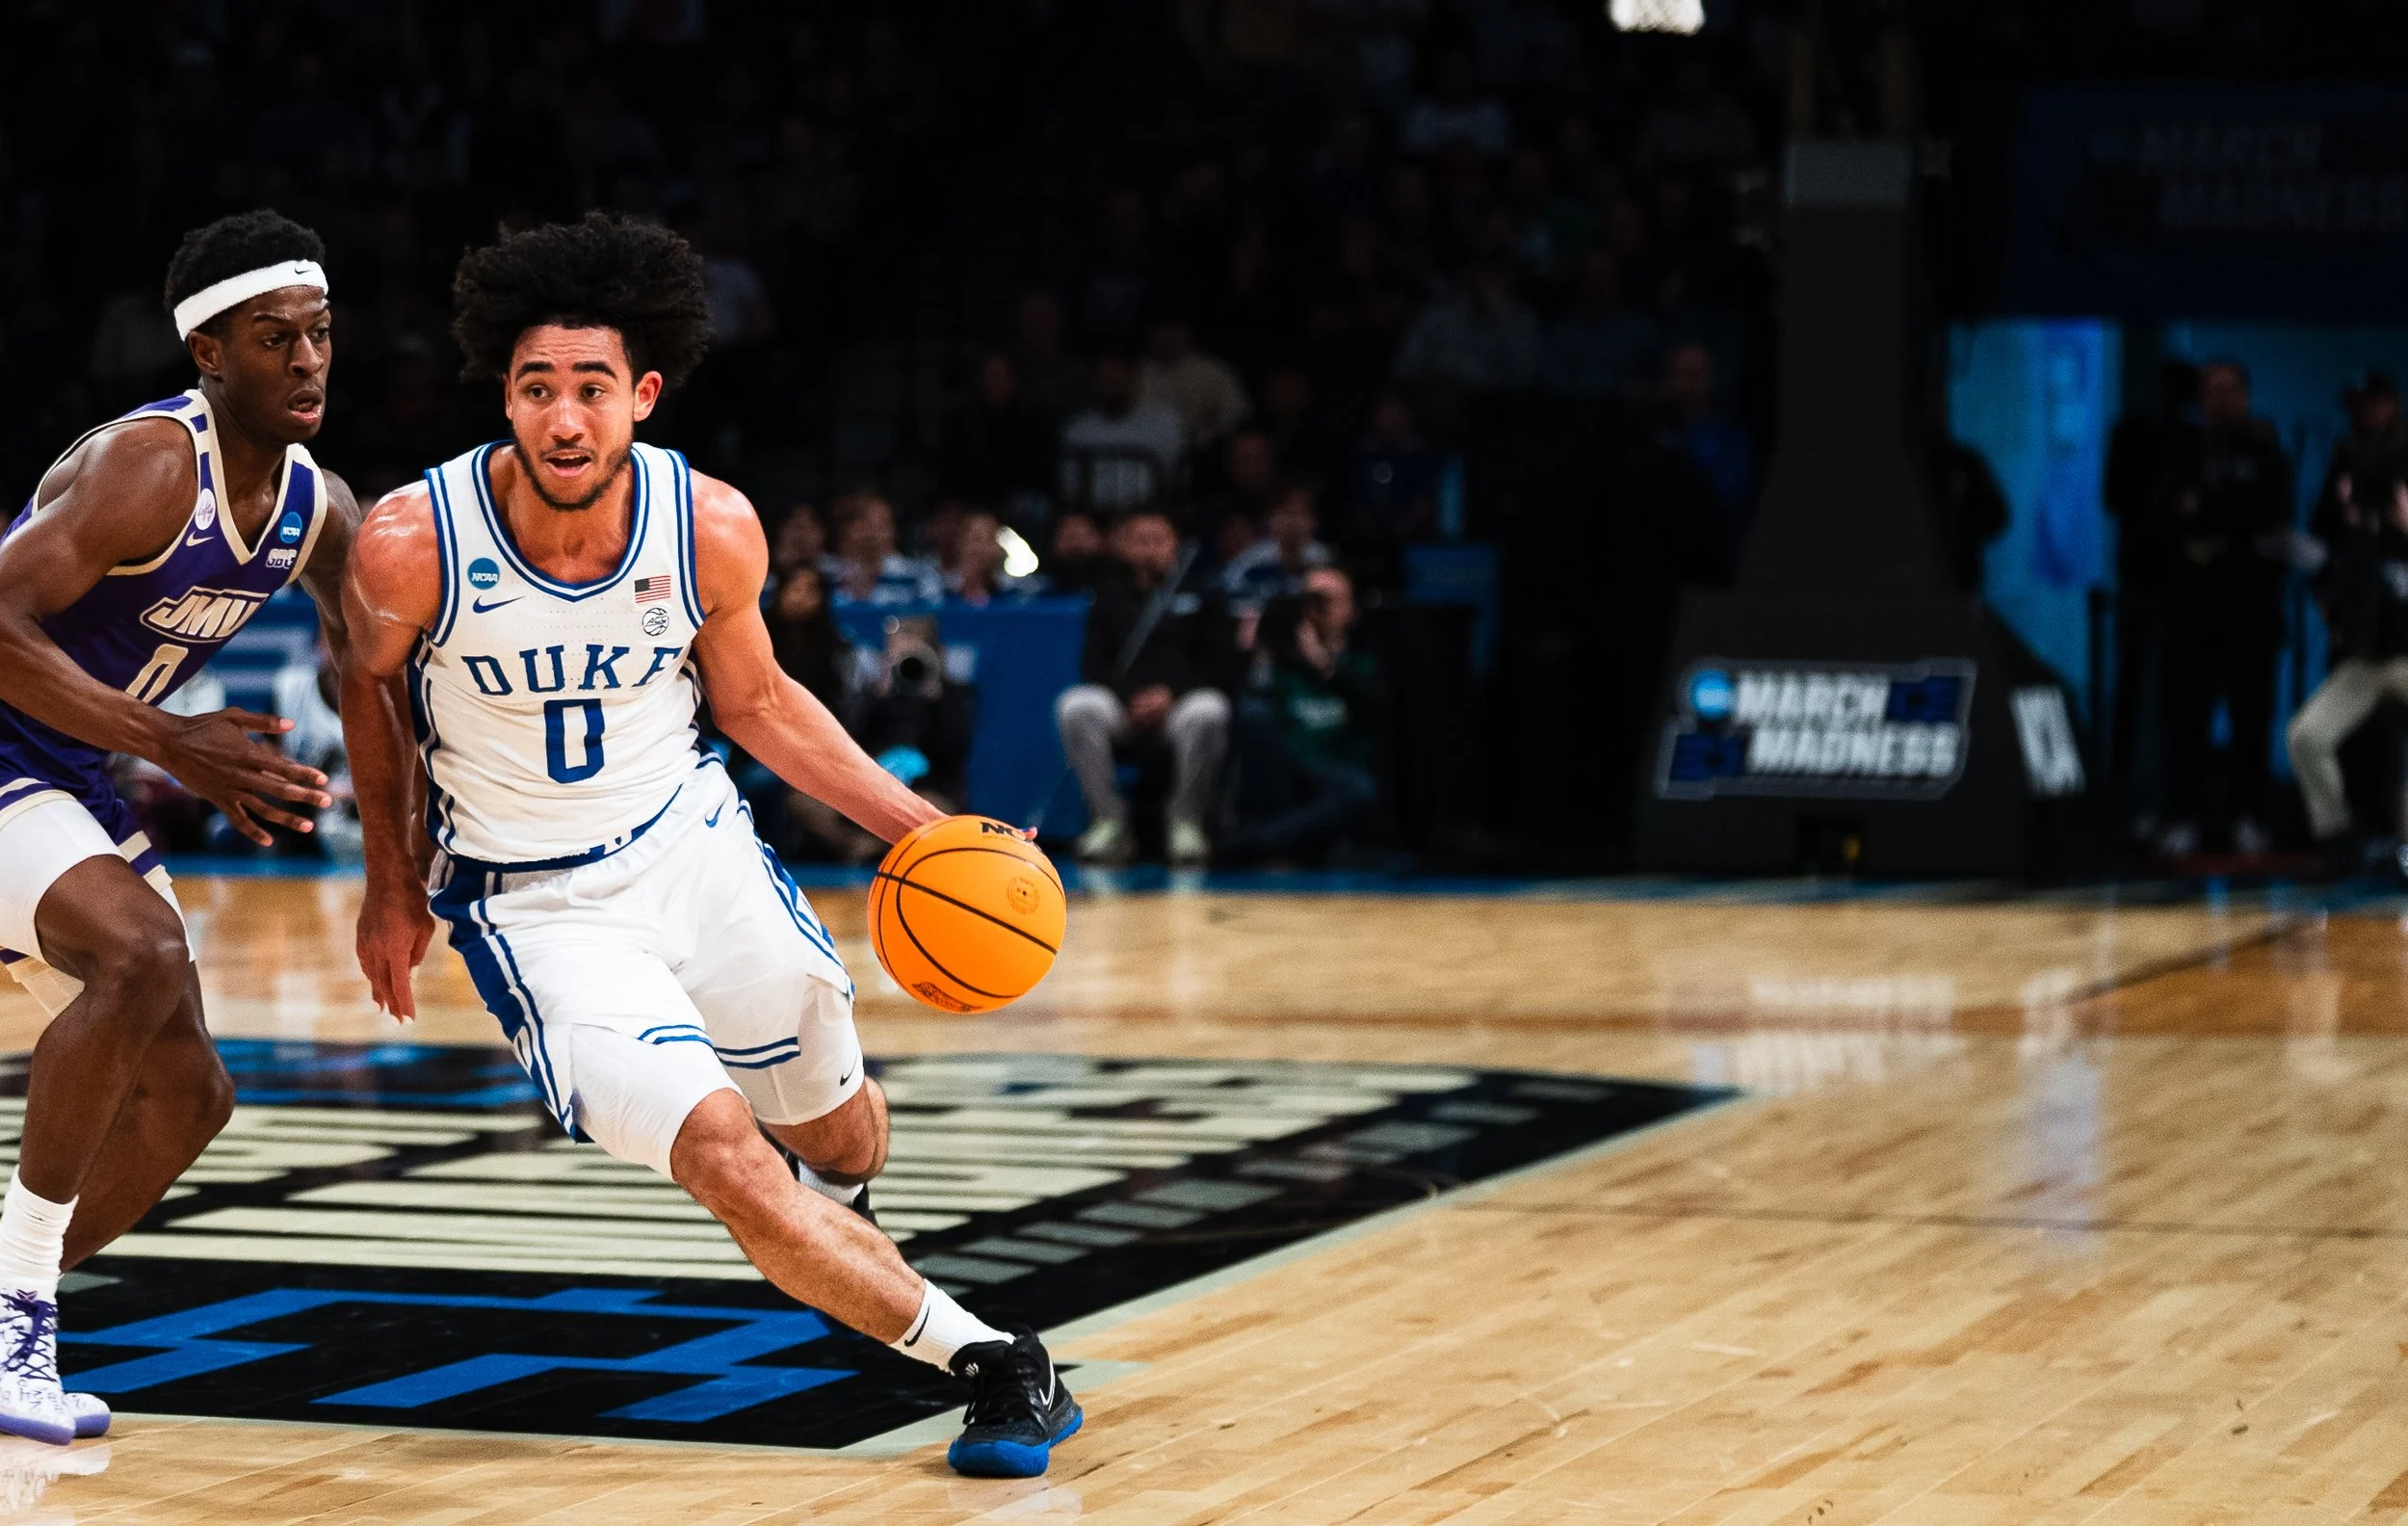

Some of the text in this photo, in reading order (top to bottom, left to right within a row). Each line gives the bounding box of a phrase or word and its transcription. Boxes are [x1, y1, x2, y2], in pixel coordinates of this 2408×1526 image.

[472, 572, 499, 583] NCAA
[147, 594, 261, 639] JMU
[125, 643, 189, 704] 0
[1736, 671, 1891, 723] MARCH
[543, 698, 605, 784] 0
[1748, 723, 1959, 776] MADNESS
